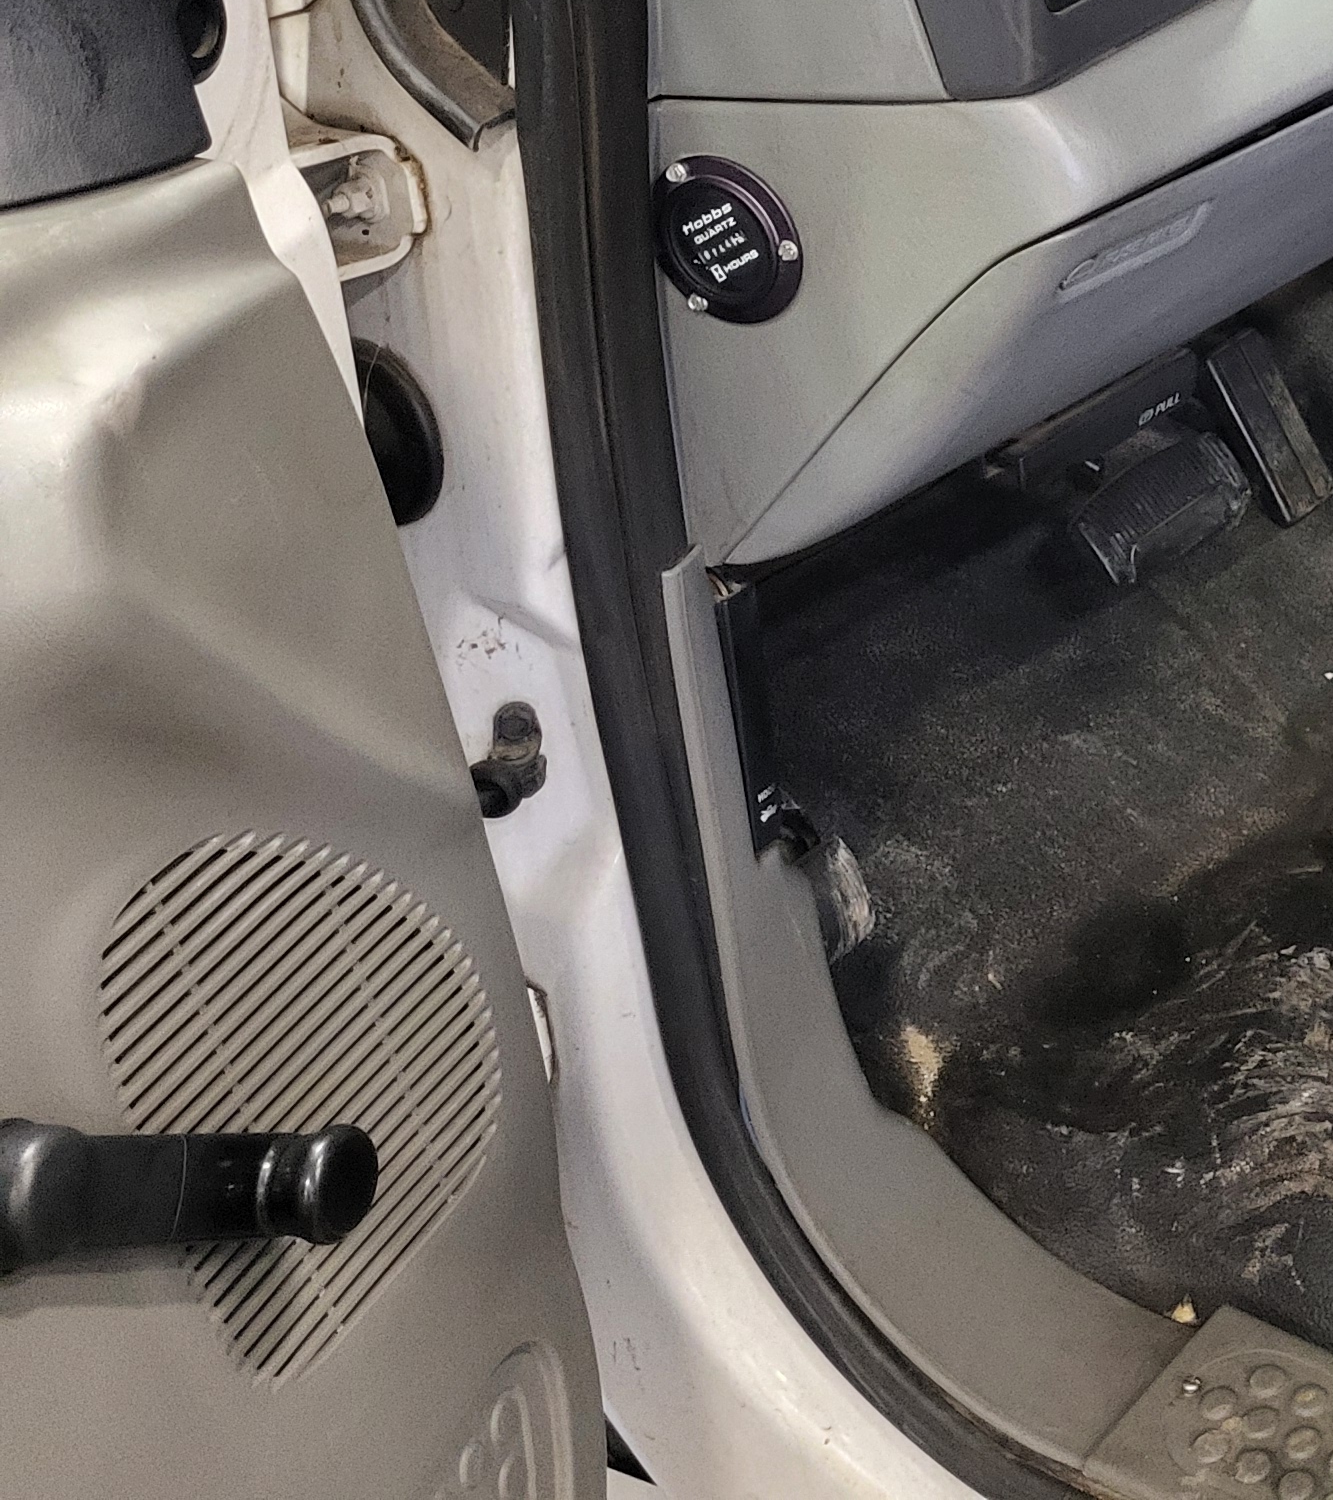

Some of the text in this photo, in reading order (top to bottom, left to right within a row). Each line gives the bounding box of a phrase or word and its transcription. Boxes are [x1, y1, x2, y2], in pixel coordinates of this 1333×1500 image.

[682, 202, 733, 236] Hobbs
[694, 216, 737, 245] QUARTZ
[724, 249, 760, 274] HOURS
[1154, 392, 1180, 417] PULL
